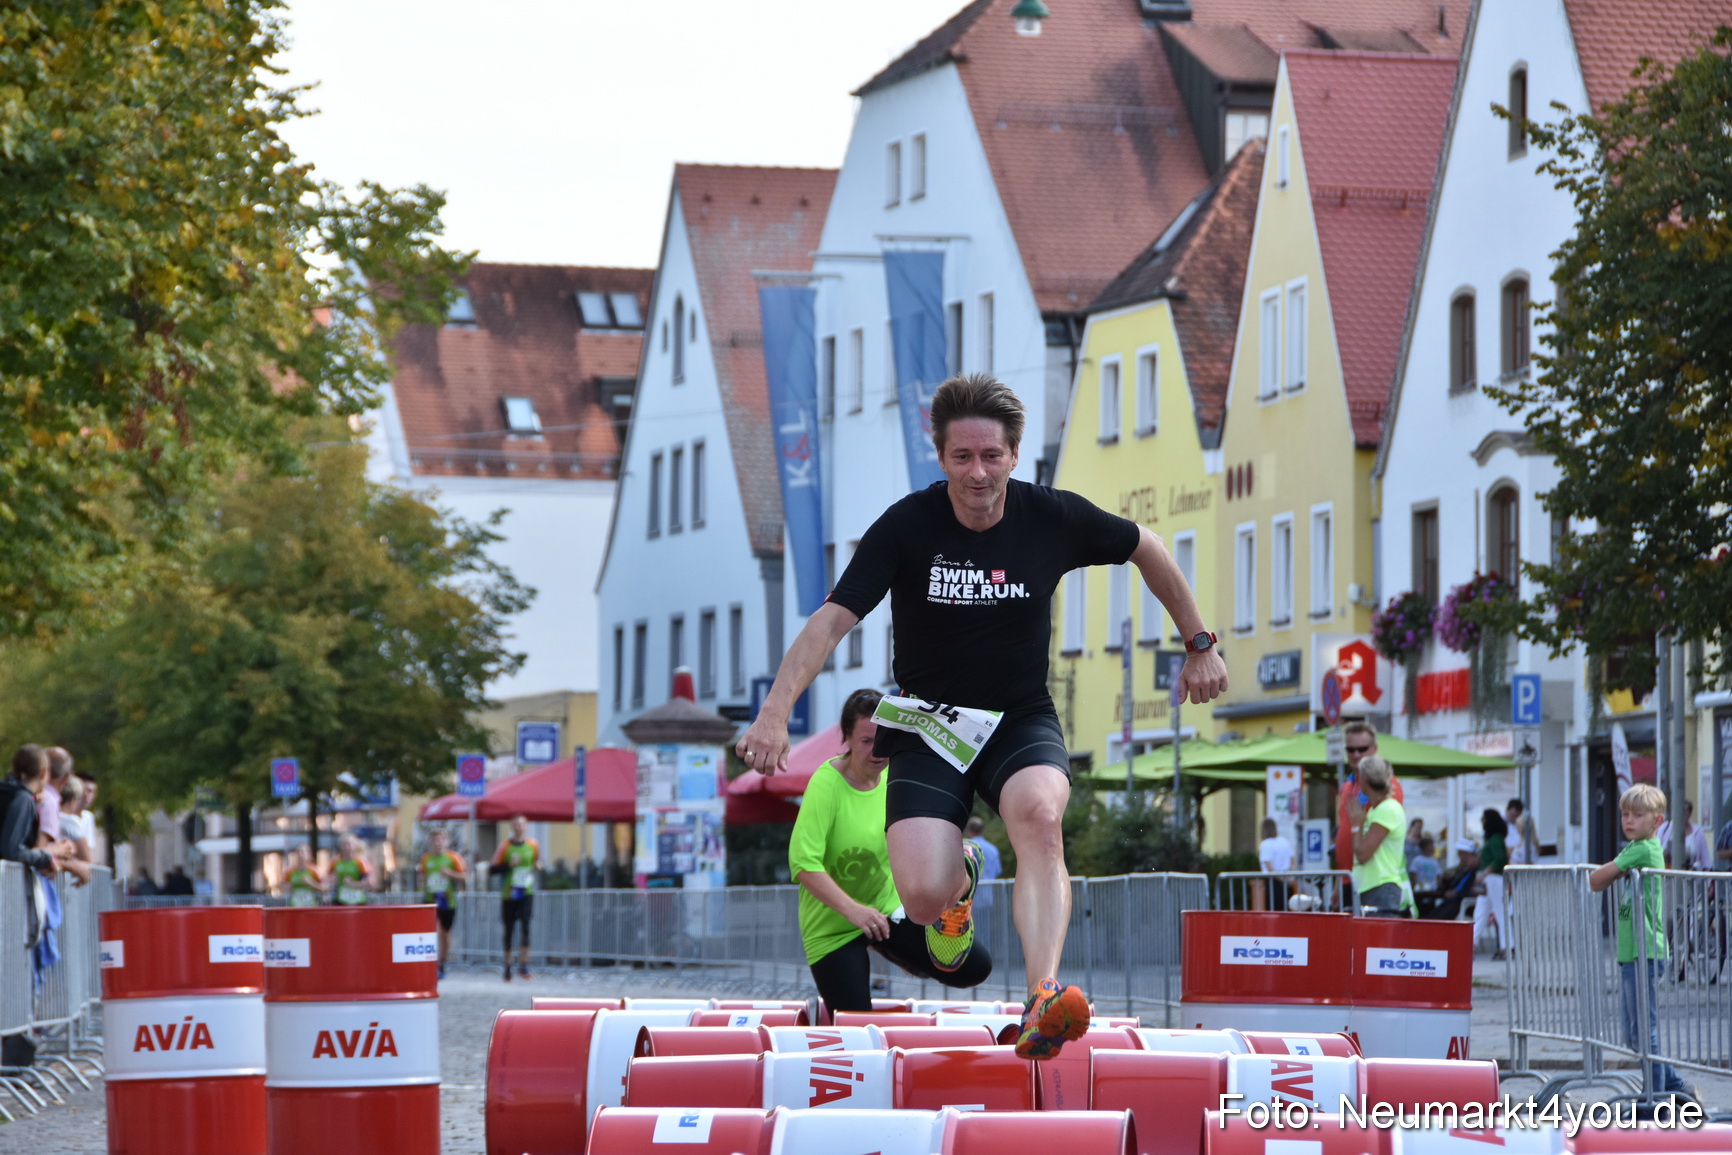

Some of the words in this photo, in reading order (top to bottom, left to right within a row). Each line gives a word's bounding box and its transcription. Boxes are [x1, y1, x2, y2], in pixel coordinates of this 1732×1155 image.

[930, 566, 990, 584] SWIM.
[897, 711, 958, 750] THOMAS
[133, 1016, 215, 1052] AVIA
[312, 1022, 399, 1059] AVIA
